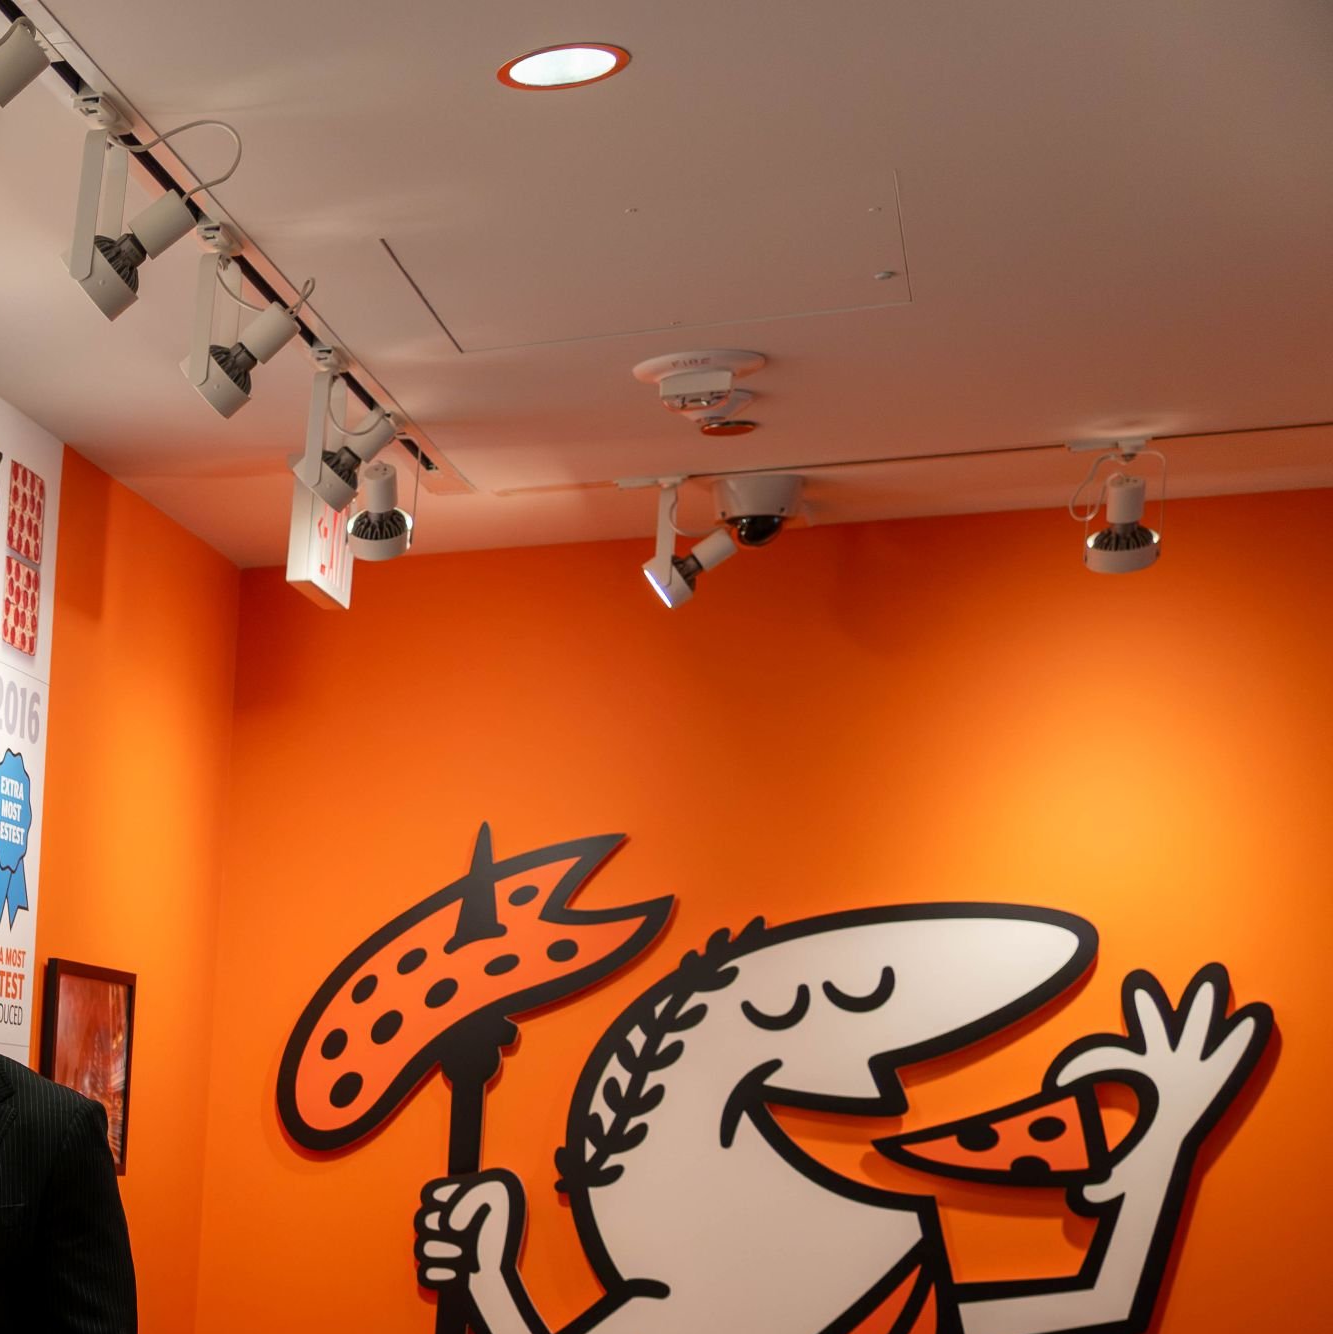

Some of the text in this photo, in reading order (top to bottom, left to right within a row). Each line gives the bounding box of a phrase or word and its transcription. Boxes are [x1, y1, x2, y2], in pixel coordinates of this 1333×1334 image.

[0, 776, 24, 800] EXTRA
[1, 799, 22, 822] MOST
[5, 947, 26, 969] MOST
